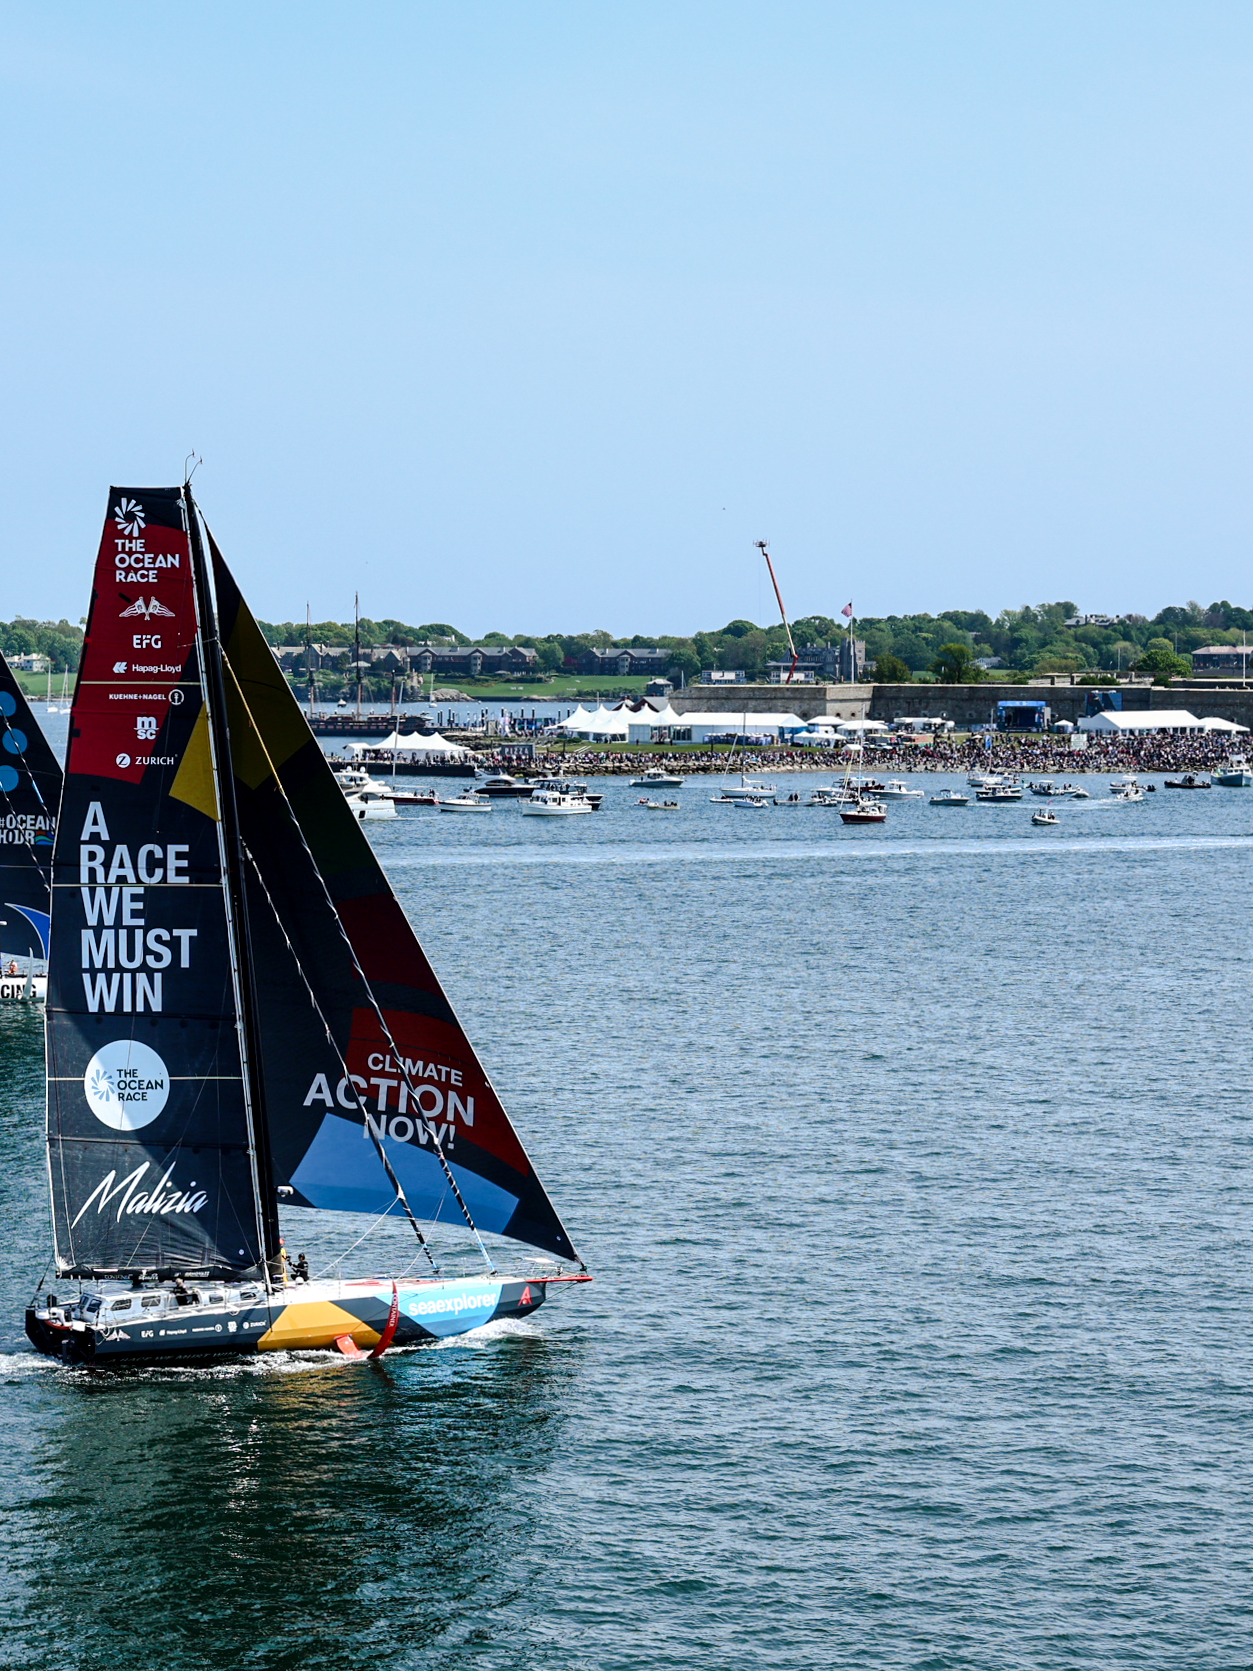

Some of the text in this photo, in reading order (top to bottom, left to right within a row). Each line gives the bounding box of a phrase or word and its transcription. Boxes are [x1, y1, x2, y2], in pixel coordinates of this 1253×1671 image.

[115, 539, 145, 551] THE
[115, 554, 180, 568] OCEAN
[115, 570, 158, 582] RACE
[133, 635, 162, 649] EFG
[132, 664, 181, 674] Hapag-Lloyd
[135, 756, 174, 765] ZURICH
[80, 801, 110, 841] A
[80, 843, 190, 884] RACE
[80, 887, 145, 926] WE
[81, 927, 198, 969] MUST
[82, 973, 162, 1012] WIN
[116, 1069, 138, 1078] THE
[367, 1053, 463, 1087] CLIMATE
[117, 1080, 164, 1091] OCEAN
[118, 1092, 148, 1102] RACE
[303, 1072, 475, 1127] ACTION
[363, 1113, 456, 1150] NOW!
[71, 1161, 209, 1229] Malizia
[409, 1293, 497, 1316] seaexplorer
